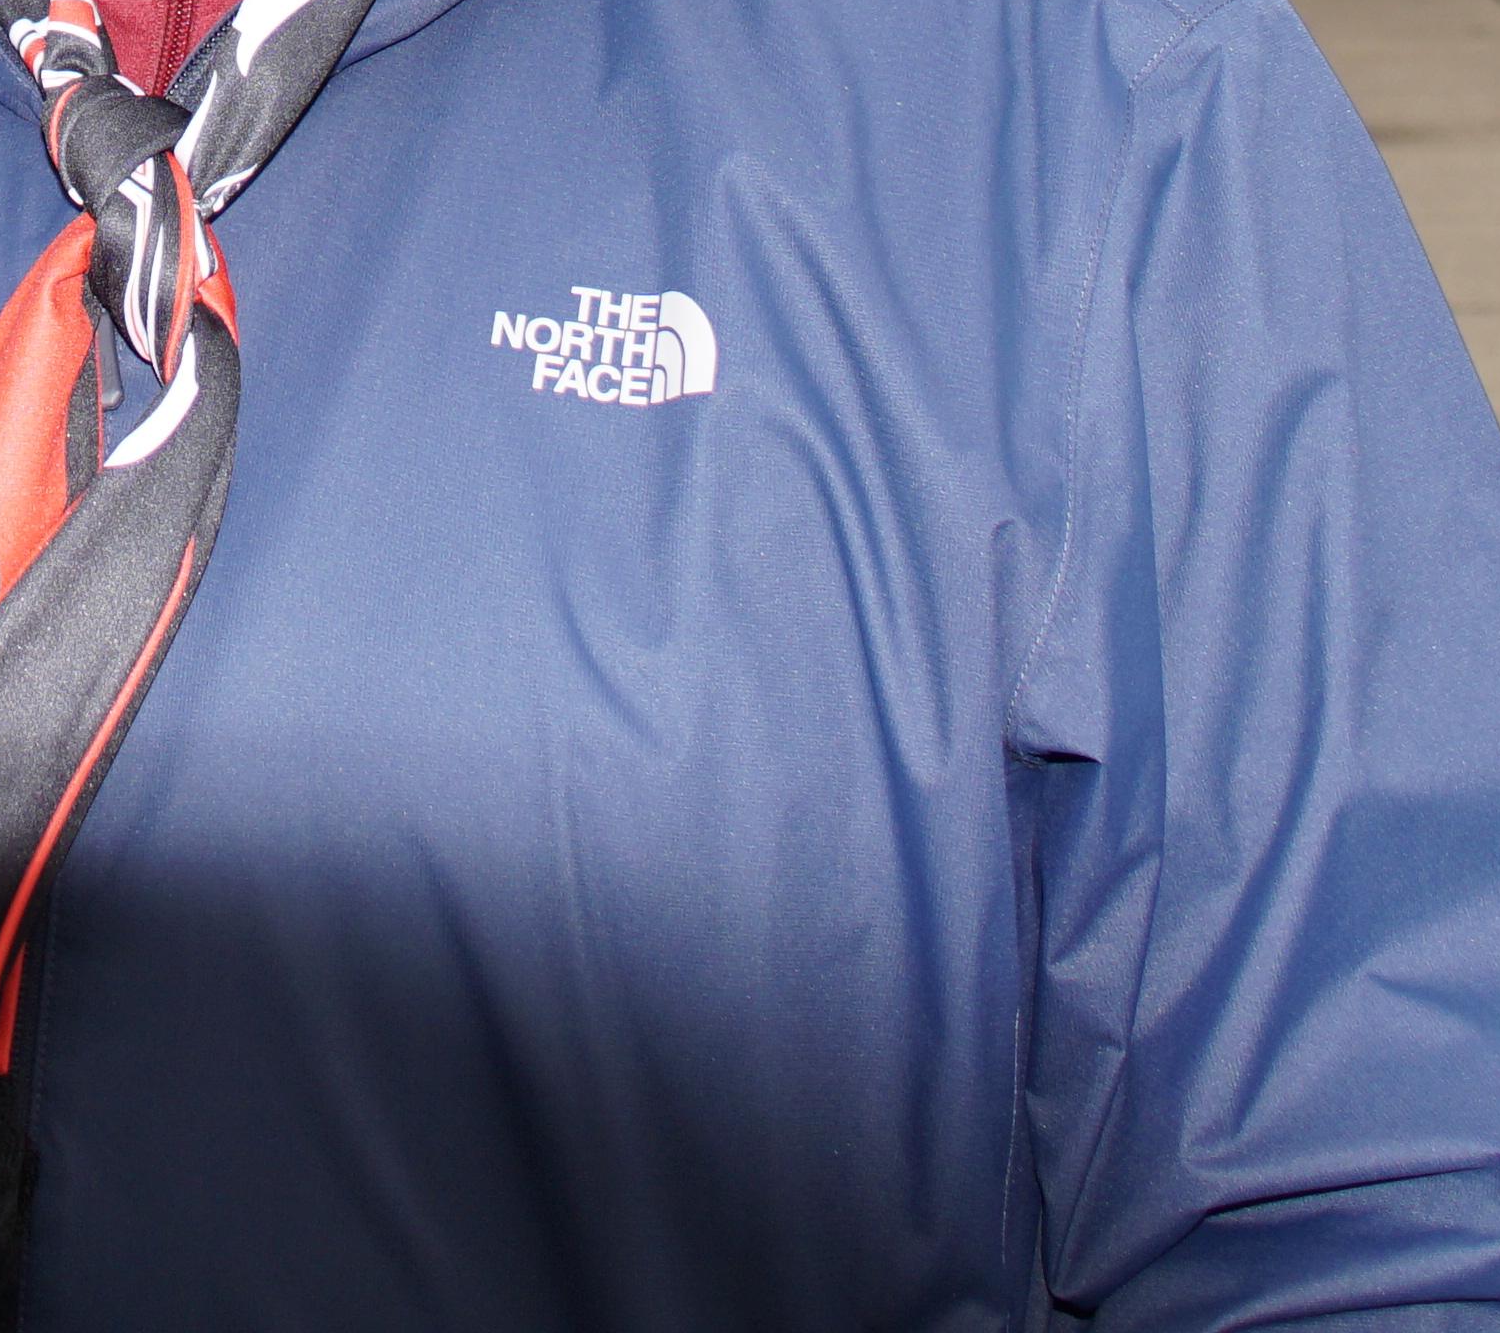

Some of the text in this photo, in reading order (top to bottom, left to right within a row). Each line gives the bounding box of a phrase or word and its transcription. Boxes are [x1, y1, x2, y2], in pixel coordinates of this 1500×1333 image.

[570, 285, 661, 332] THE
[490, 310, 657, 369] NORTH
[531, 353, 649, 406] FACE
